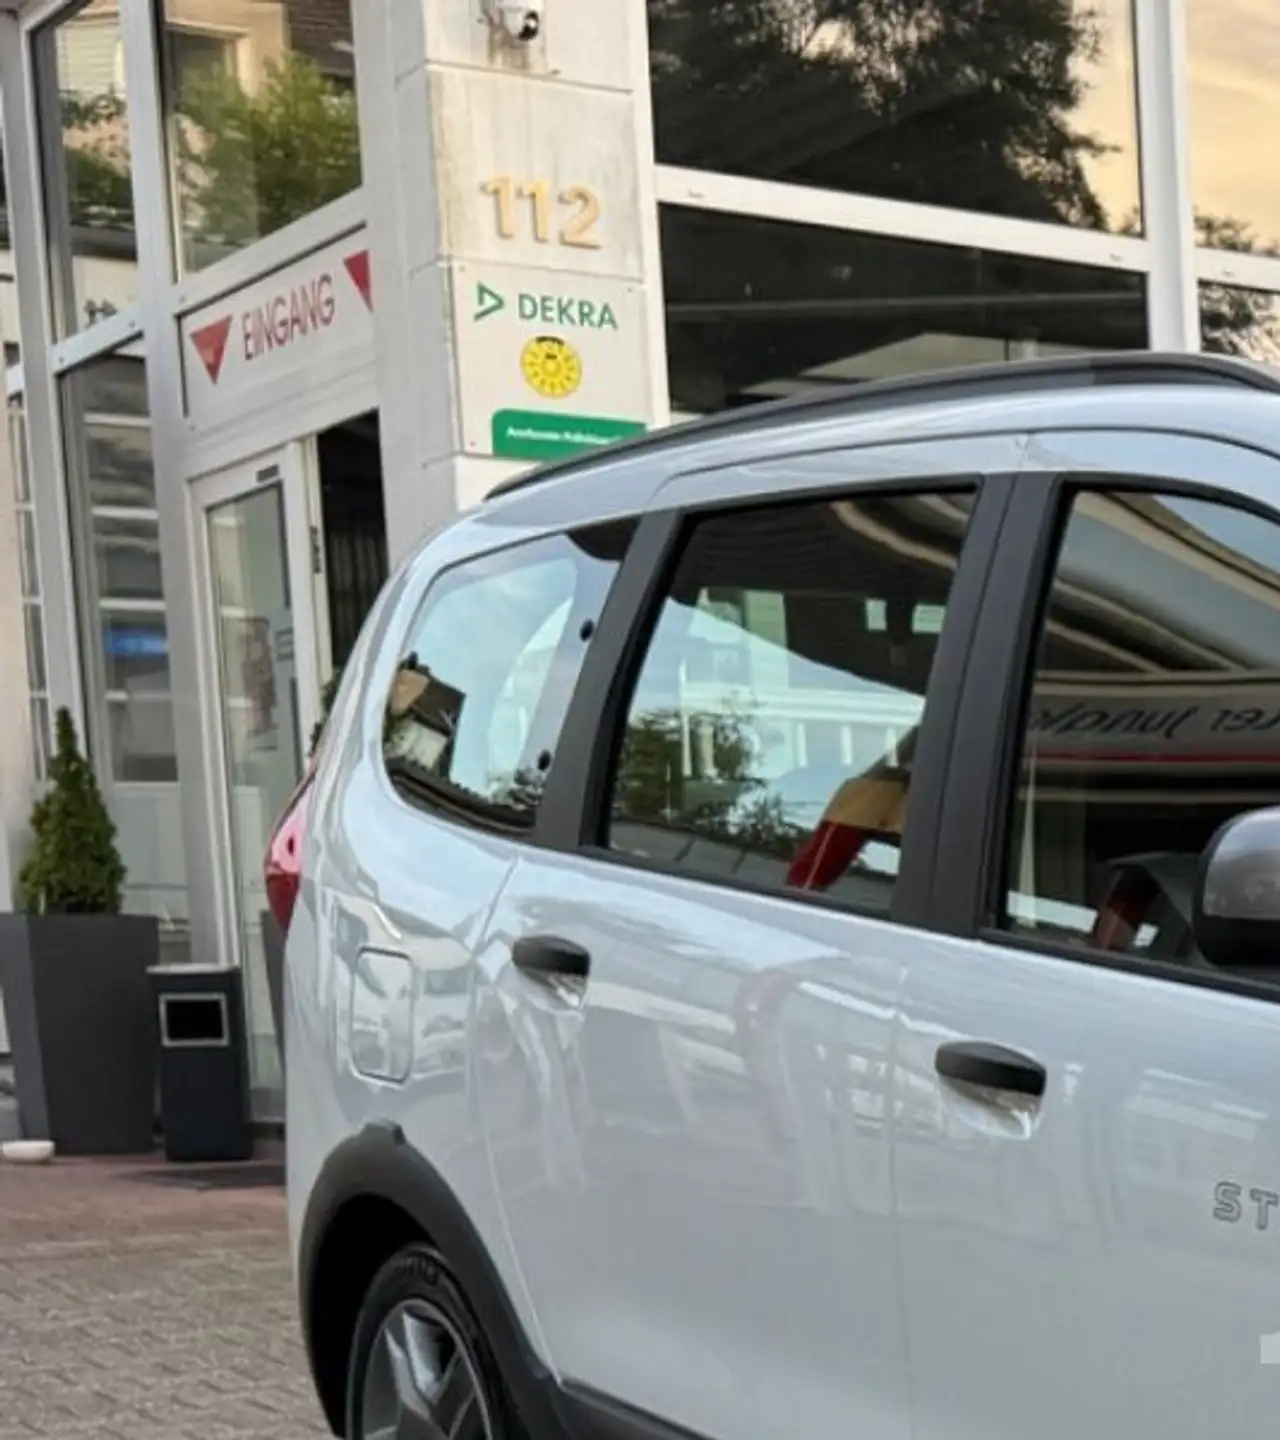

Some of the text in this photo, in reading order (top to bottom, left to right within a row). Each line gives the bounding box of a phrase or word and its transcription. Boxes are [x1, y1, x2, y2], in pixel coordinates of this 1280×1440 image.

[481, 176, 602, 250] 112
[241, 272, 336, 361] EINGANG
[517, 292, 618, 331] DEKRA
